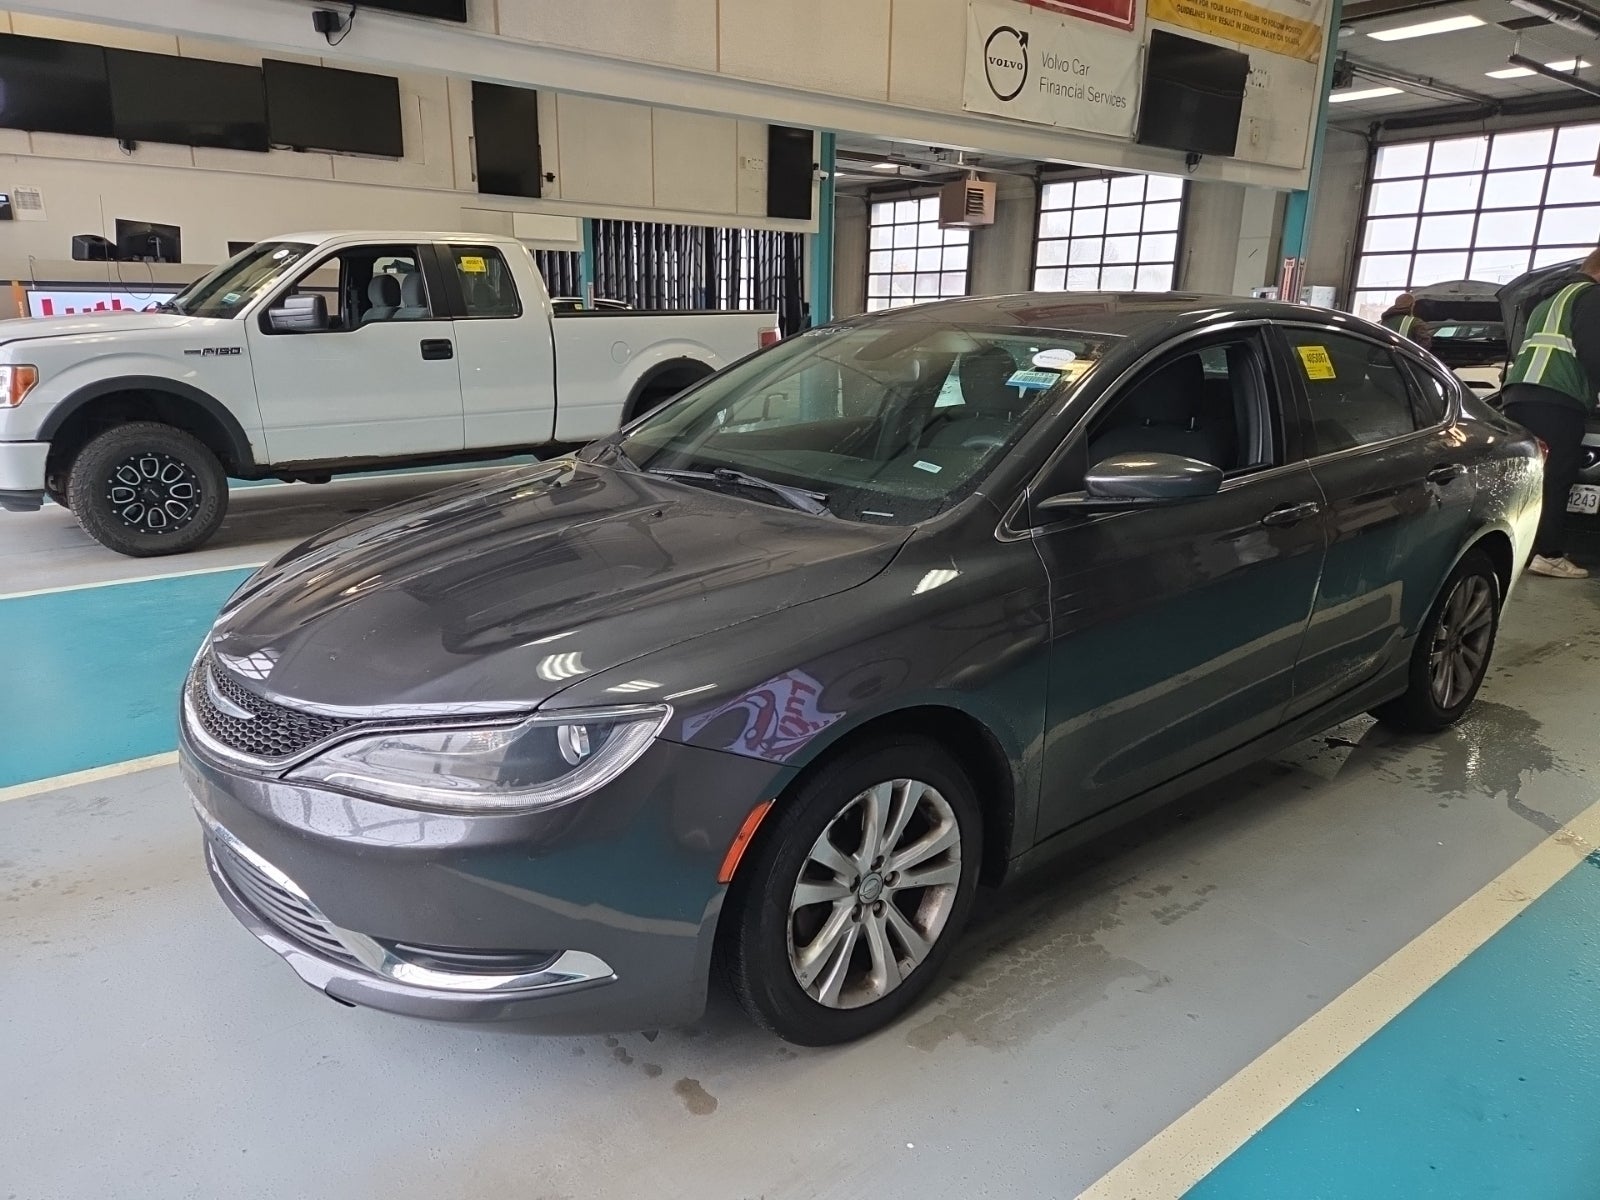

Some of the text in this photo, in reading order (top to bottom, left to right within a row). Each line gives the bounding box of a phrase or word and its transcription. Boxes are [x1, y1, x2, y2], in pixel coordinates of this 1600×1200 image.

[988, 56, 1024, 71] VOLVO
[1041, 51, 1091, 76] Volvo Car
[1039, 77, 1127, 109] Financial Services
